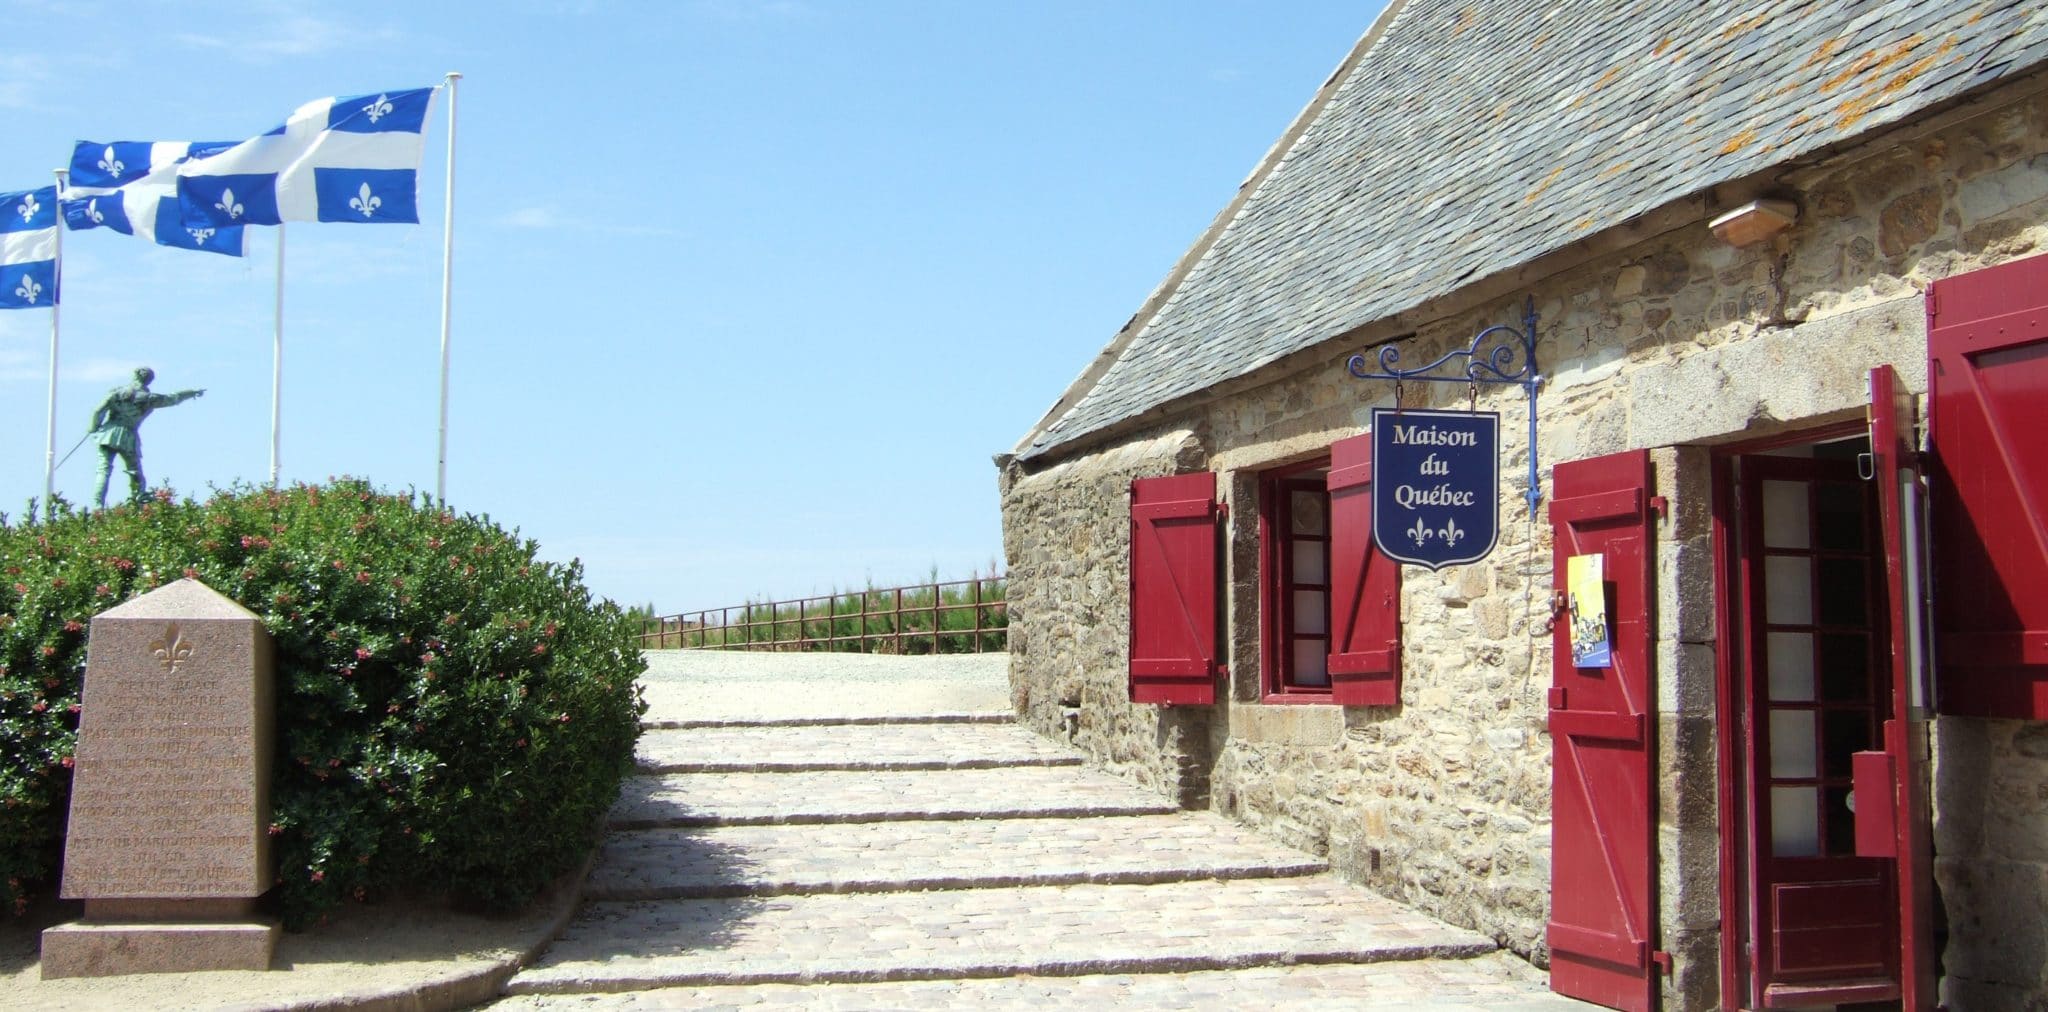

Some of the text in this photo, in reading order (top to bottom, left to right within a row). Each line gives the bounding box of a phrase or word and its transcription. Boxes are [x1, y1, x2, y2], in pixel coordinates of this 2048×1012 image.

[1392, 425, 1477, 446] Maison
[1420, 453, 1449, 475] du
[1395, 484, 1474, 509] Québec
